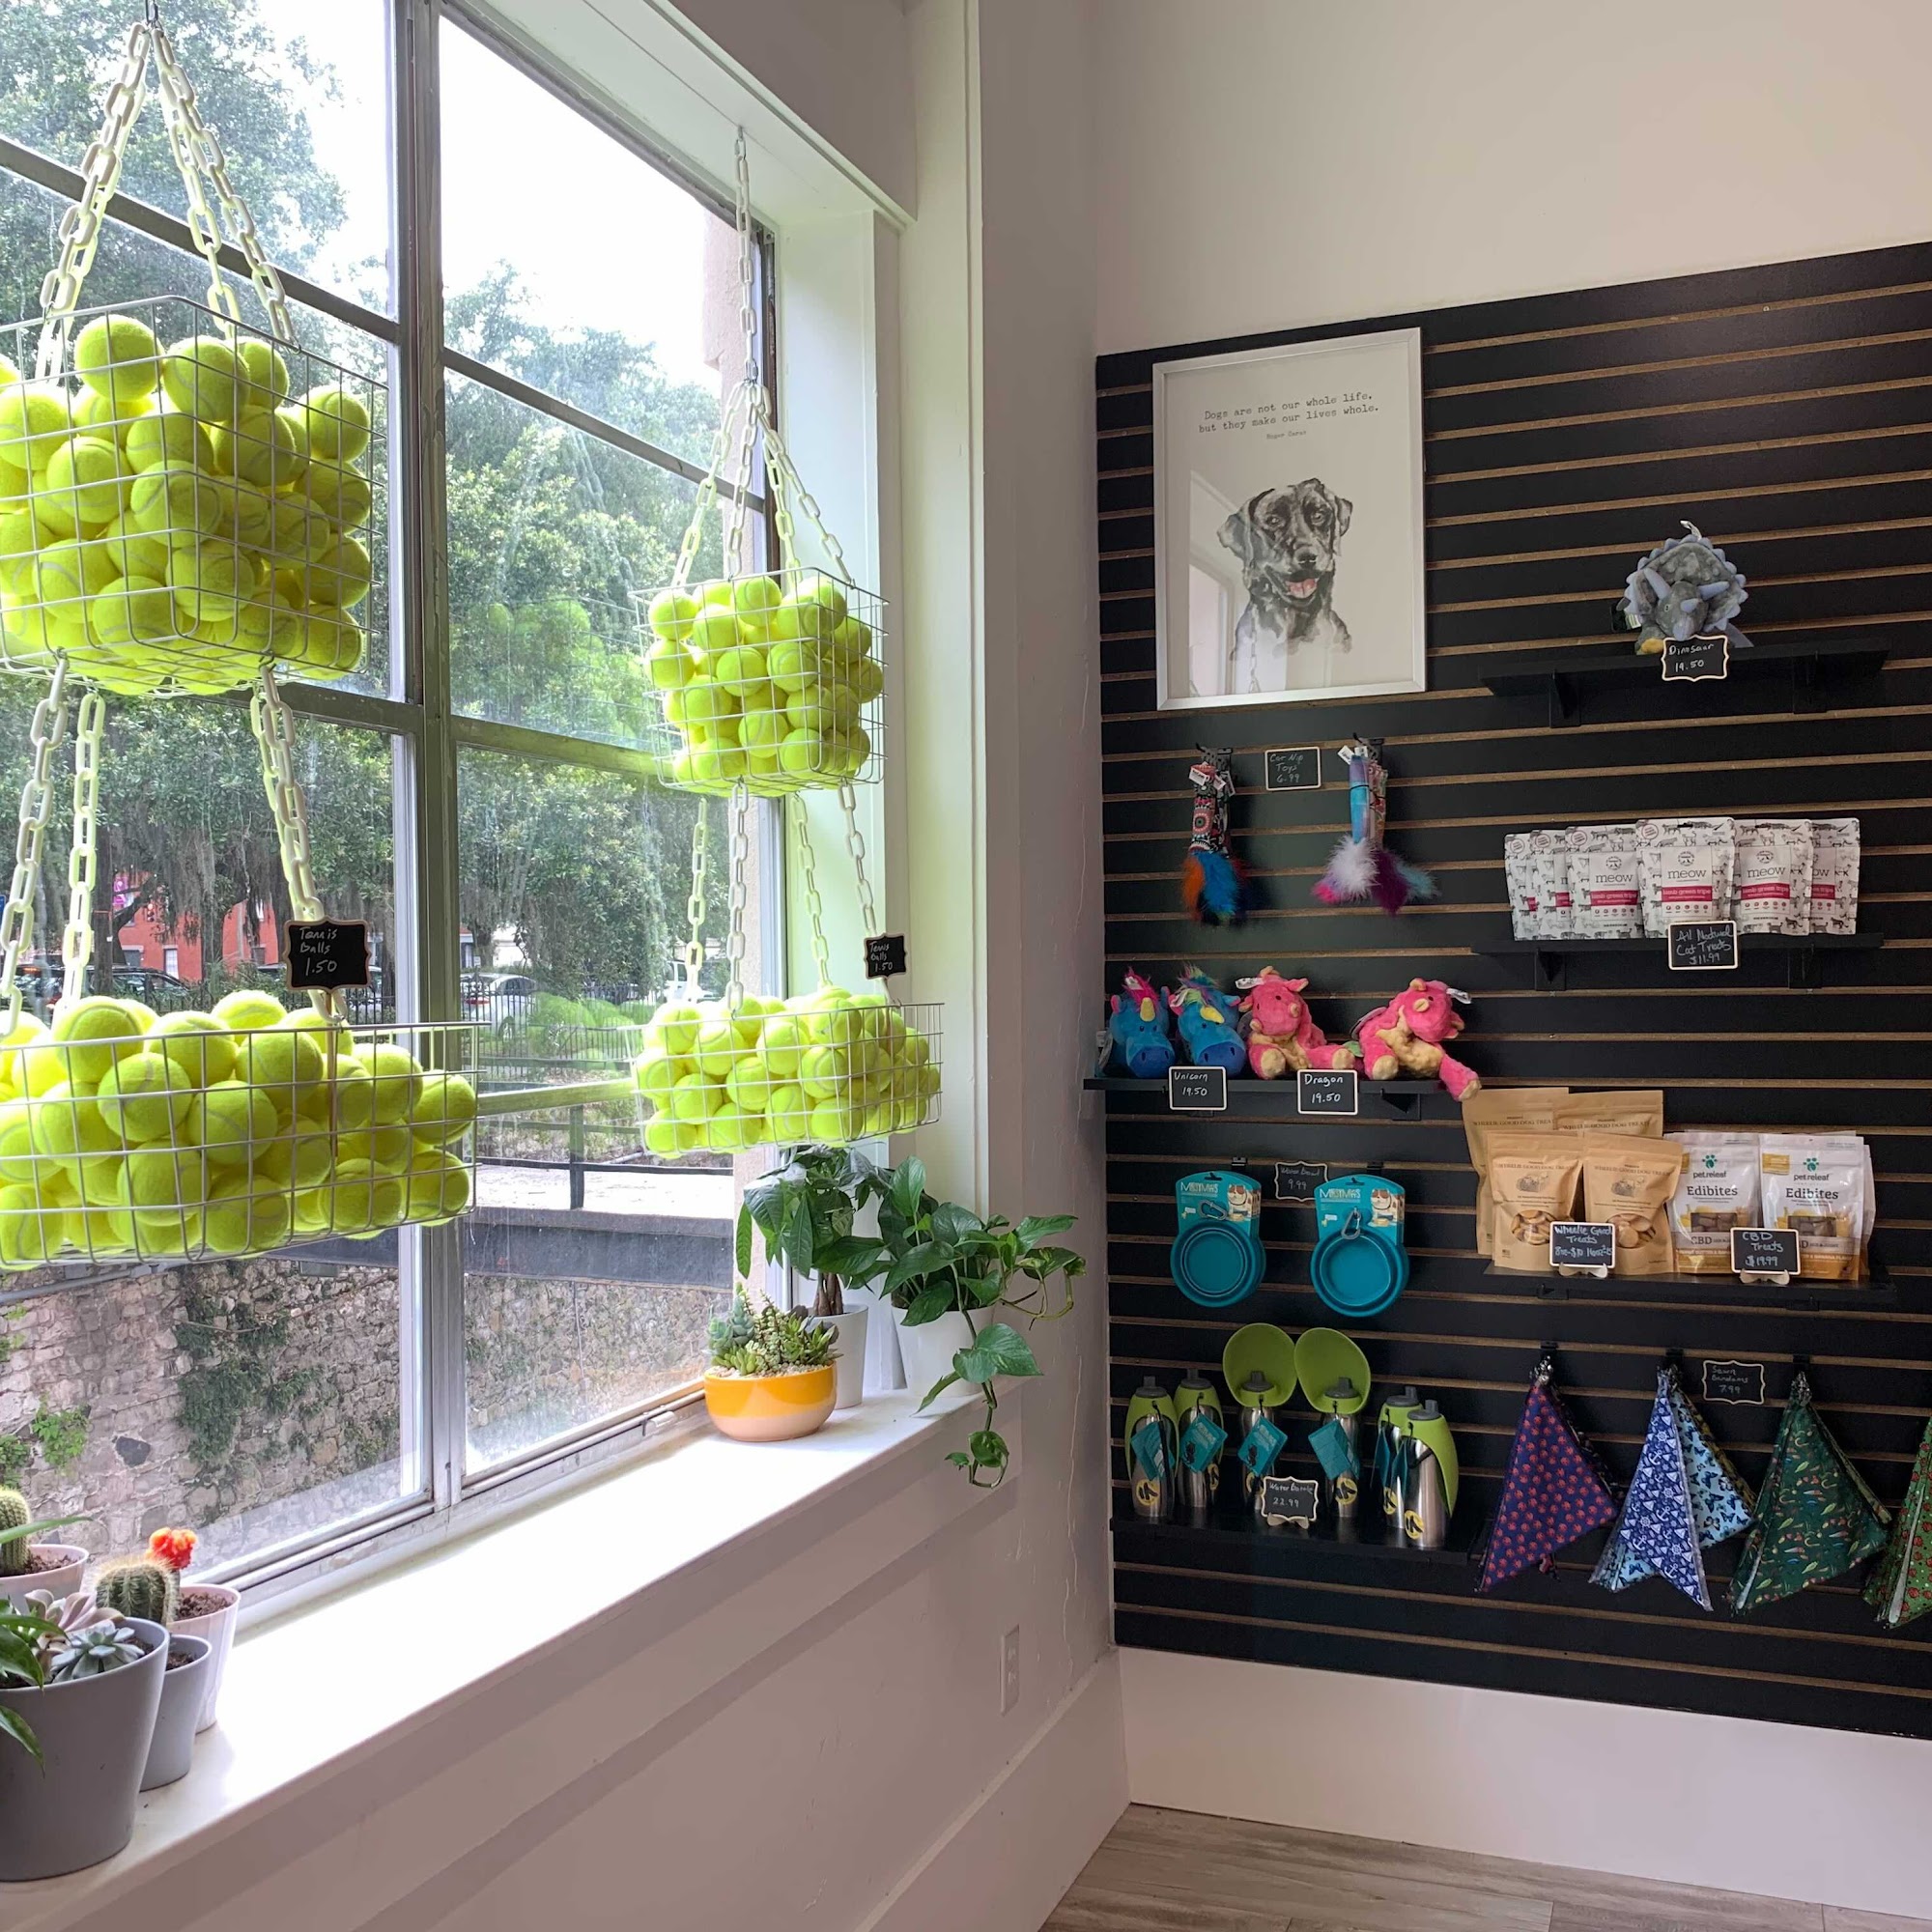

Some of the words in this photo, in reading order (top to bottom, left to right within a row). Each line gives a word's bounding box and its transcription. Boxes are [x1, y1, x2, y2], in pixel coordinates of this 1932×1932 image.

[1205, 411, 1228, 420] Dogs
[1234, 408, 1252, 417] are
[1258, 404, 1276, 413] not
[1281, 401, 1300, 411] our
[1306, 396, 1337, 407] whole
[1199, 424, 1217, 433] but
[1223, 421, 1246, 431] they
[1252, 416, 1276, 427] make
[1282, 414, 1301, 423] our
[1306, 409, 1337, 420] lives
[1669, 643, 1714, 655] Dinosaur
[1276, 762, 1297, 774] Toys
[1277, 773, 1300, 783] 6.99
[1668, 870, 1706, 880] meow
[1747, 867, 1786, 878] meow
[1595, 874, 1634, 883] meow
[299, 927, 338, 940] Tennis
[1676, 929, 1692, 941] All
[1697, 924, 1733, 941] Natural
[300, 941, 331, 954] Balls
[869, 940, 889, 952] Tennis
[1677, 944, 1696, 956] Cat
[1697, 939, 1732, 952] Treats
[870, 951, 887, 961] Balls
[1689, 952, 1719, 965] $11.99
[305, 957, 338, 976] 1.50
[875, 962, 893, 972] 1.50
[1174, 1071, 1208, 1081] Unicorn
[1304, 1073, 1343, 1087] Dragon
[1182, 1086, 1208, 1096] 19.50
[1311, 1093, 1341, 1104] 19.50
[1288, 1179, 1307, 1190] 9.99
[1686, 1186, 1738, 1196] Edibites
[1785, 1188, 1839, 1199] Edibites
[1554, 1225, 1588, 1235] Wheelie
[1590, 1226, 1612, 1236] Good
[1742, 1231, 1773, 1241] CBD
[1566, 1235, 1597, 1244] Treats
[1691, 1236, 1712, 1245] CBD
[1750, 1241, 1784, 1252] Treats
[1719, 1385, 1741, 1393] 7.99
[1269, 1482, 1290, 1491] Water
[1273, 1497, 1299, 1507] 22.99
